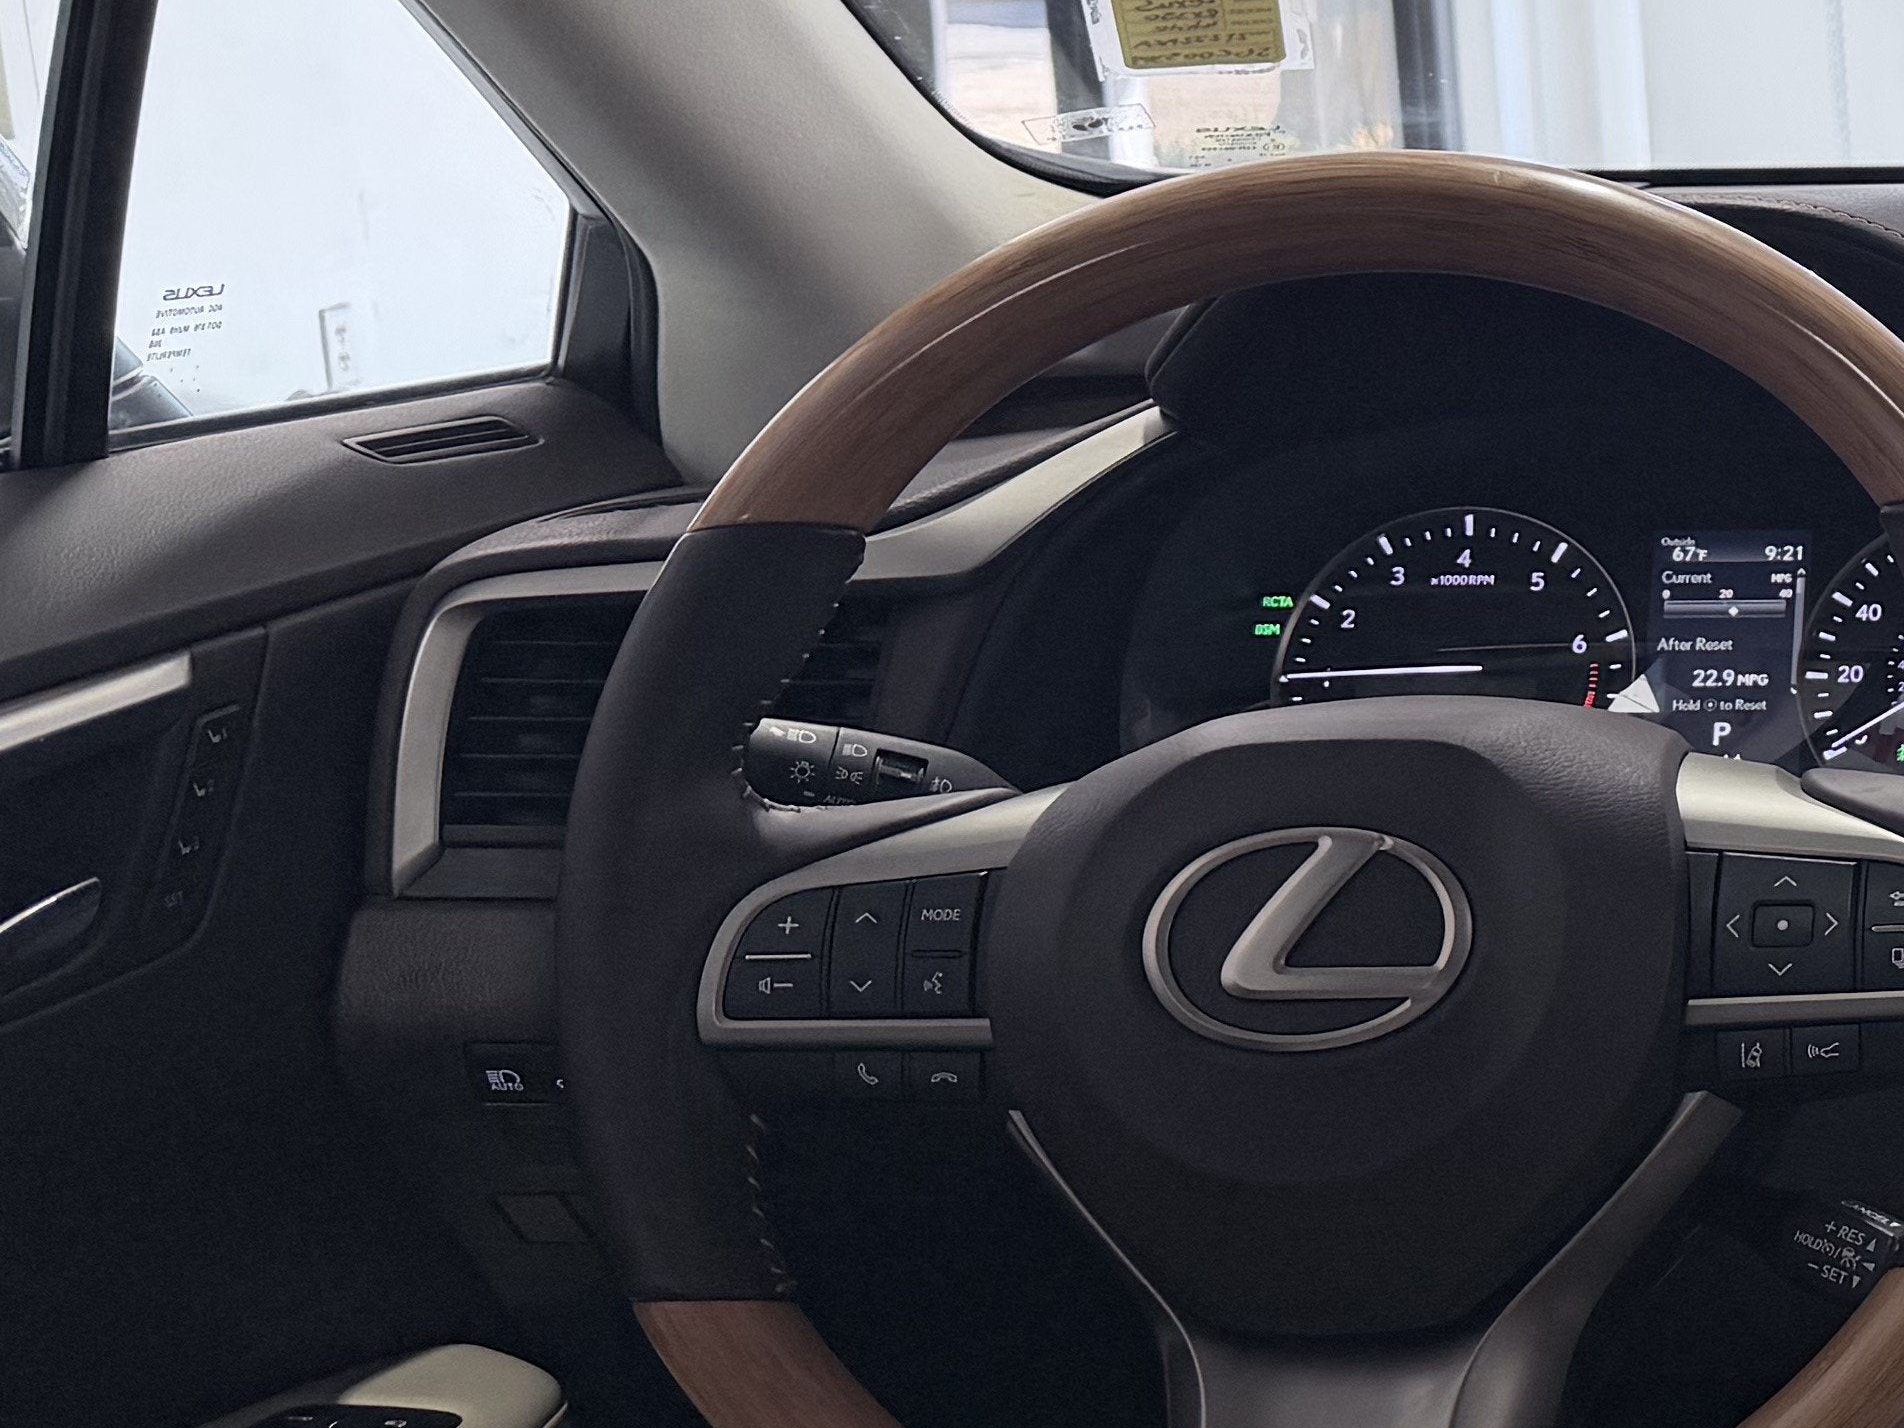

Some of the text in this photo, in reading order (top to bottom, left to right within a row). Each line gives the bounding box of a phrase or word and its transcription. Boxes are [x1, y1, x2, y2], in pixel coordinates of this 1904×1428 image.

[1456, 548, 1472, 568] 4
[1765, 545, 1804, 561] 9:21
[1390, 566, 1405, 586] 3
[1529, 571, 1545, 591] 5
[1661, 571, 1712, 584] Current
[1262, 596, 1293, 608] RCTA
[1719, 589, 1734, 598] 20
[1340, 609, 1356, 629] 2
[1855, 603, 1882, 621] 40
[1572, 634, 1587, 653] 6
[1657, 637, 1733, 651] After Reset
[1692, 669, 1770, 687] 22.9 MPG
[1837, 665, 1864, 683] 20
[1672, 699, 1767, 711] Hold to Reset
[1712, 721, 1732, 746] P
[921, 908, 961, 921] MODE
[1794, 1230, 1823, 1251] HOLD
[1837, 1225, 1866, 1246] RES
[1821, 1264, 1848, 1284] SET
